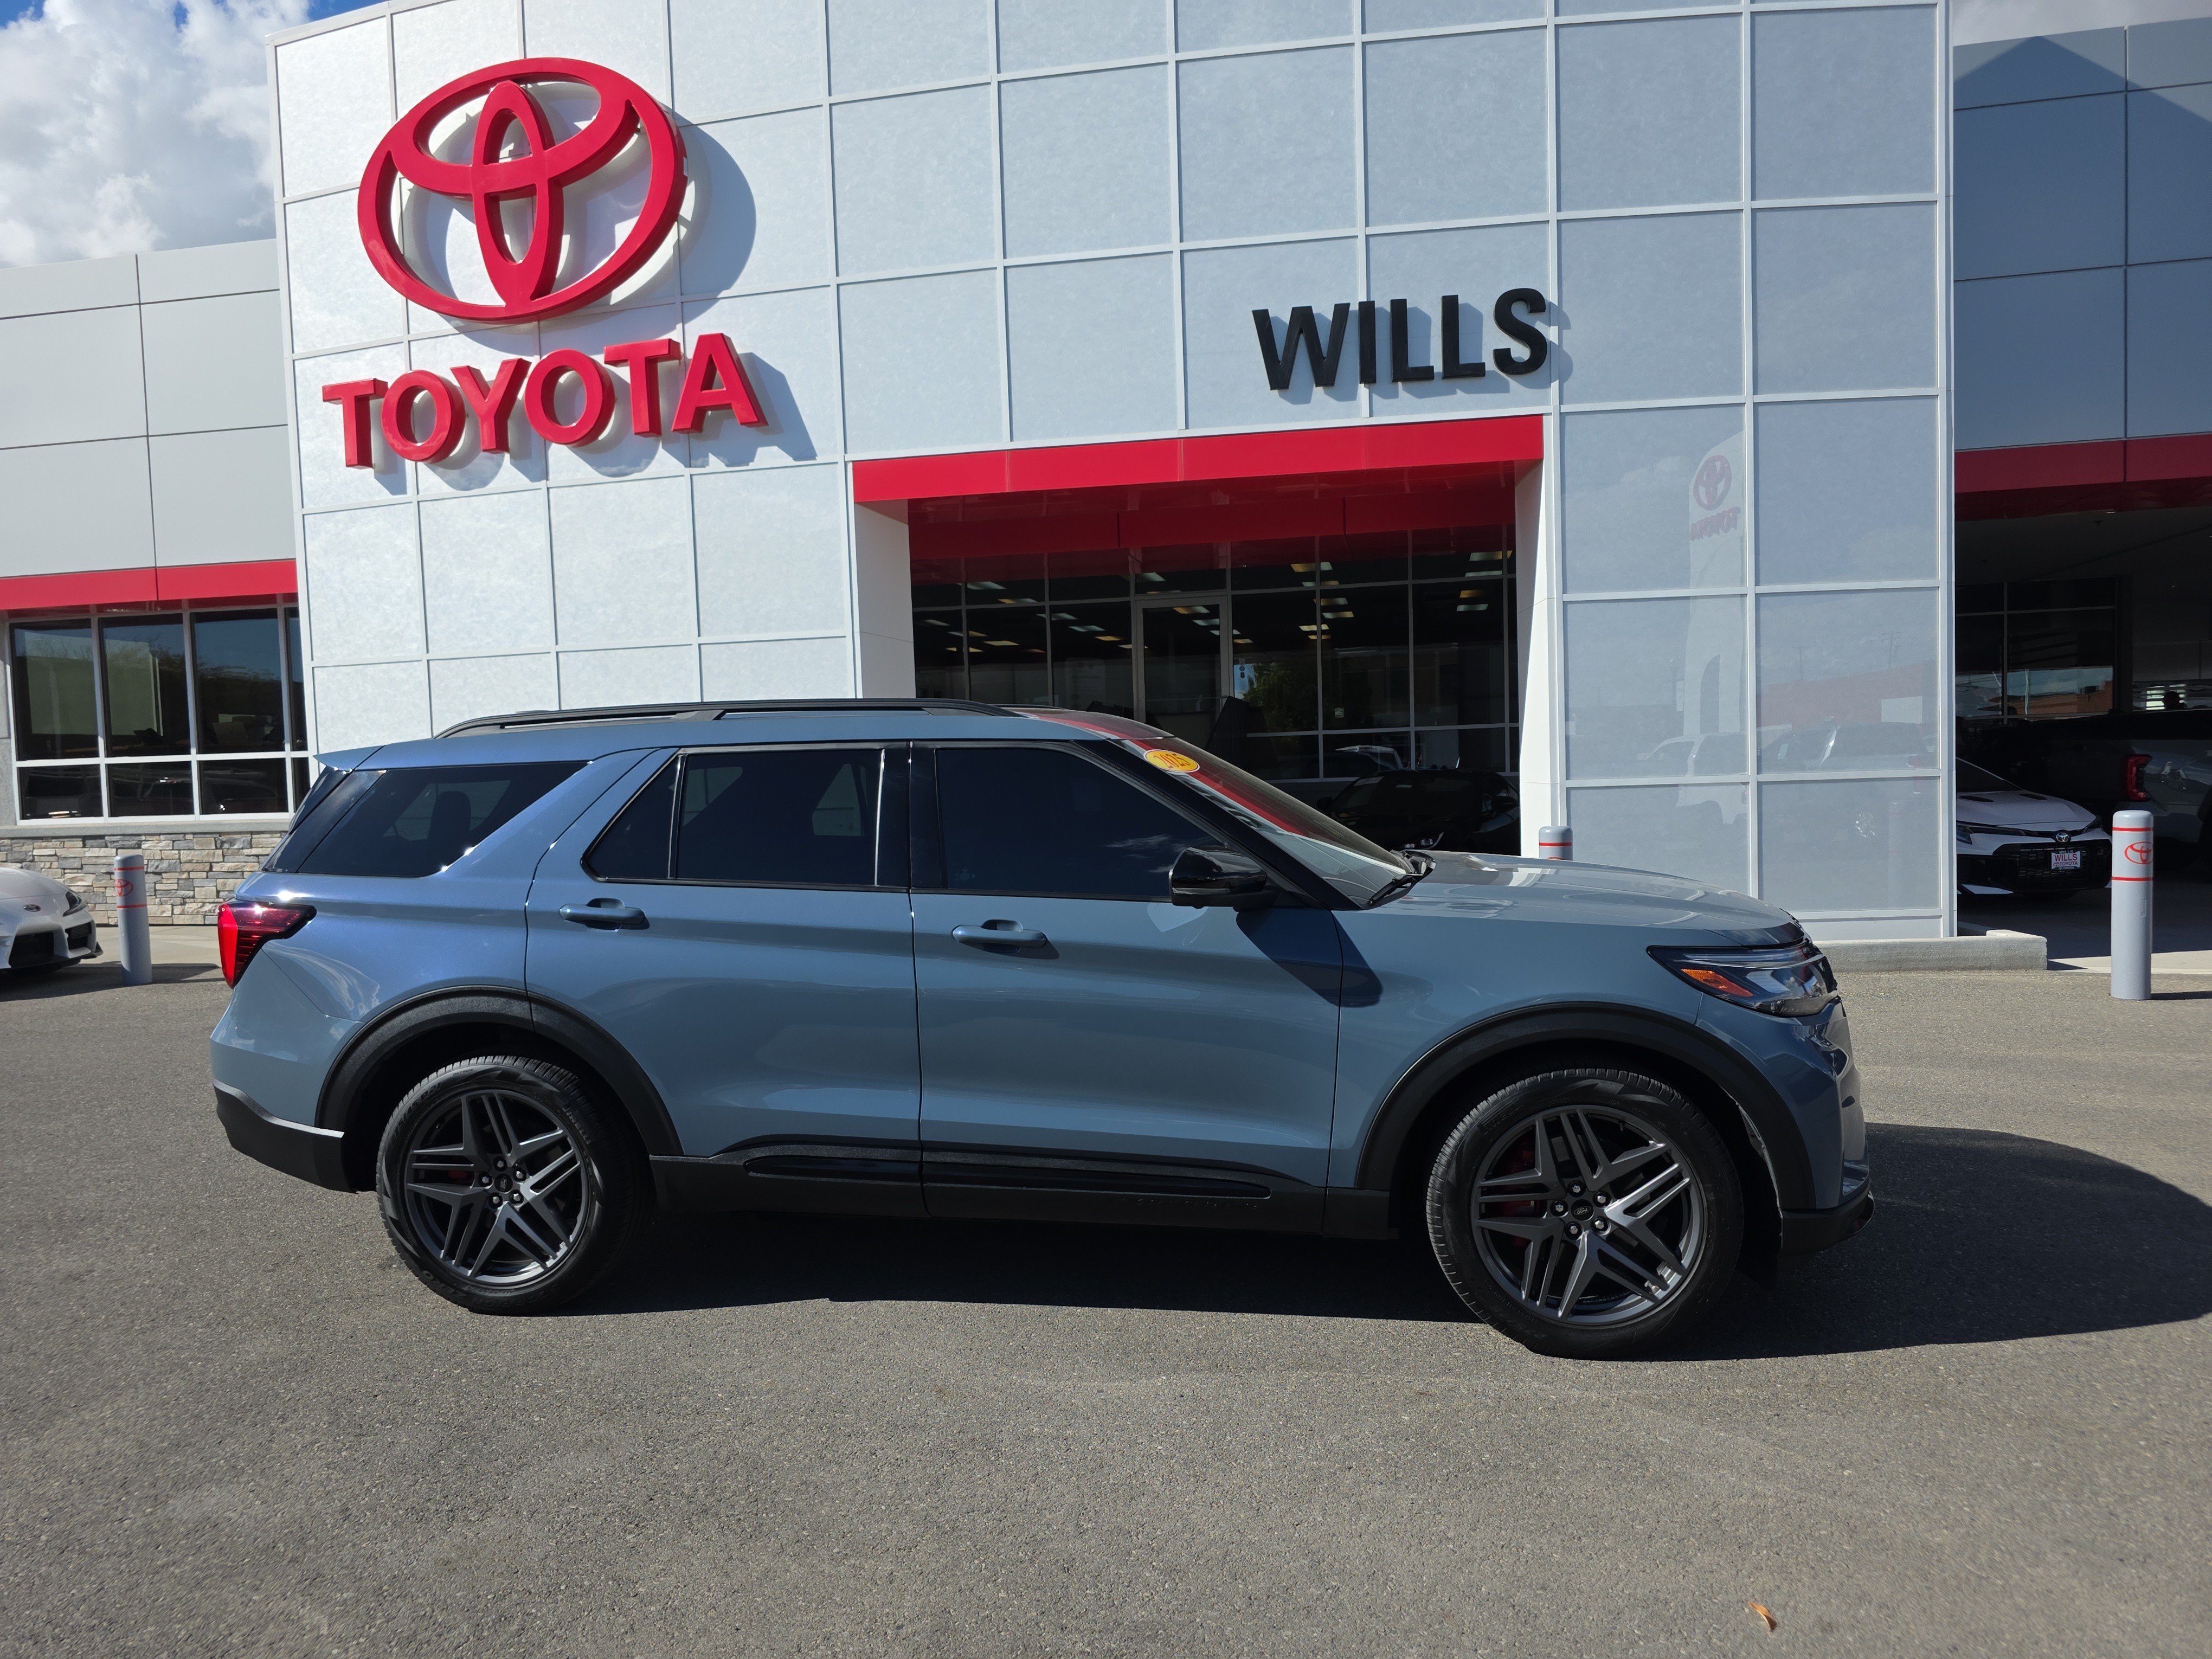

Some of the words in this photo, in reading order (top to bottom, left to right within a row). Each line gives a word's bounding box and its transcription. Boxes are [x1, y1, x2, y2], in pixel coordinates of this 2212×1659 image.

[1252, 287, 1549, 391] WILLS
[322, 333, 768, 468] TOYOTA
[1153, 753, 1191, 769] 2025
